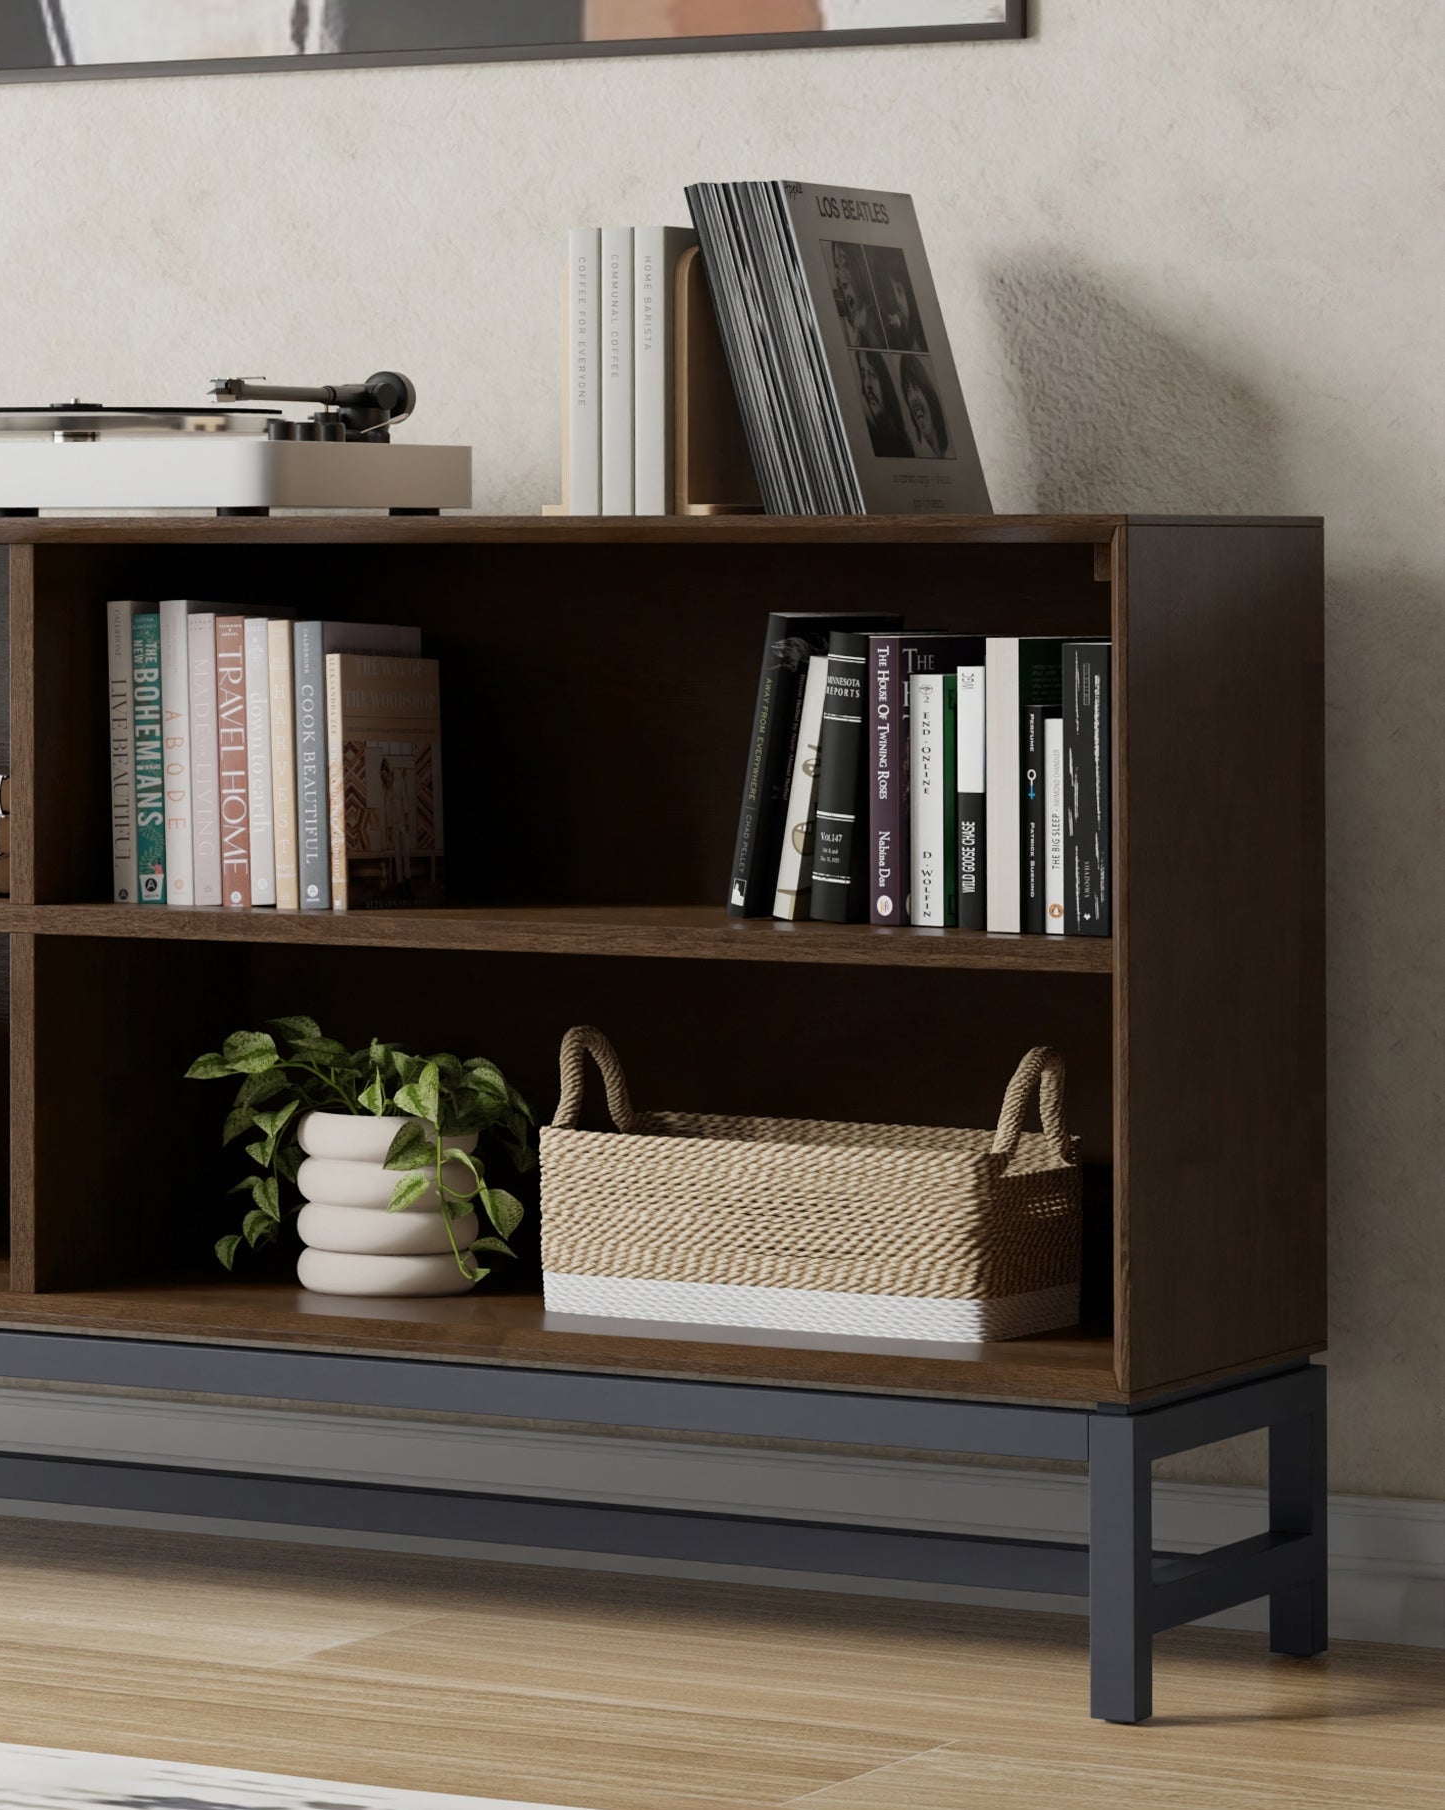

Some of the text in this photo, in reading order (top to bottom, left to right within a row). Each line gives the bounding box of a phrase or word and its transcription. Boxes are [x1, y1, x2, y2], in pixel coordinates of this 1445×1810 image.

[816, 195, 889, 225] LOS BEATLES
[578, 256, 586, 406] COFFEE FOR EVERYONE
[611, 254, 619, 379] COMMUNAL COFFEE
[643, 255, 652, 350] HOME BARISTA
[133, 640, 143, 663] NEW
[145, 643, 158, 663] THE
[356, 658, 378, 676] THE
[902, 648, 934, 674] THE
[194, 659, 211, 735] MADE
[218, 645, 245, 760] TRAVEL
[826, 686, 860, 698] REPORTS
[877, 645, 890, 800] THE HOUSE OF TWINING ROSES
[111, 680, 130, 868] LIVE BEAUTIFUL
[133, 668, 163, 826] BOHEMIANS
[165, 710, 187, 830] ABODE
[250, 692, 271, 833] down to earth
[273, 684, 290, 854] HARVEST
[301, 684, 318, 864] COOK BEAUTIFUL
[748, 677, 773, 800] AWAY FROM EVERYWHERE
[196, 763, 215, 857] LIVING
[221, 771, 249, 875] HOME
[739, 815, 753, 873] CHAD PELLEY
[1052, 813, 1061, 836] SLEEP
[1052, 837, 1060, 853] BIG
[878, 831, 891, 867] Nabina
[878, 868, 891, 887] Das
[923, 851, 932, 859] D
[961, 821, 975, 893] WILD GOOSE CHASE
[1051, 854, 1060, 870] THE
